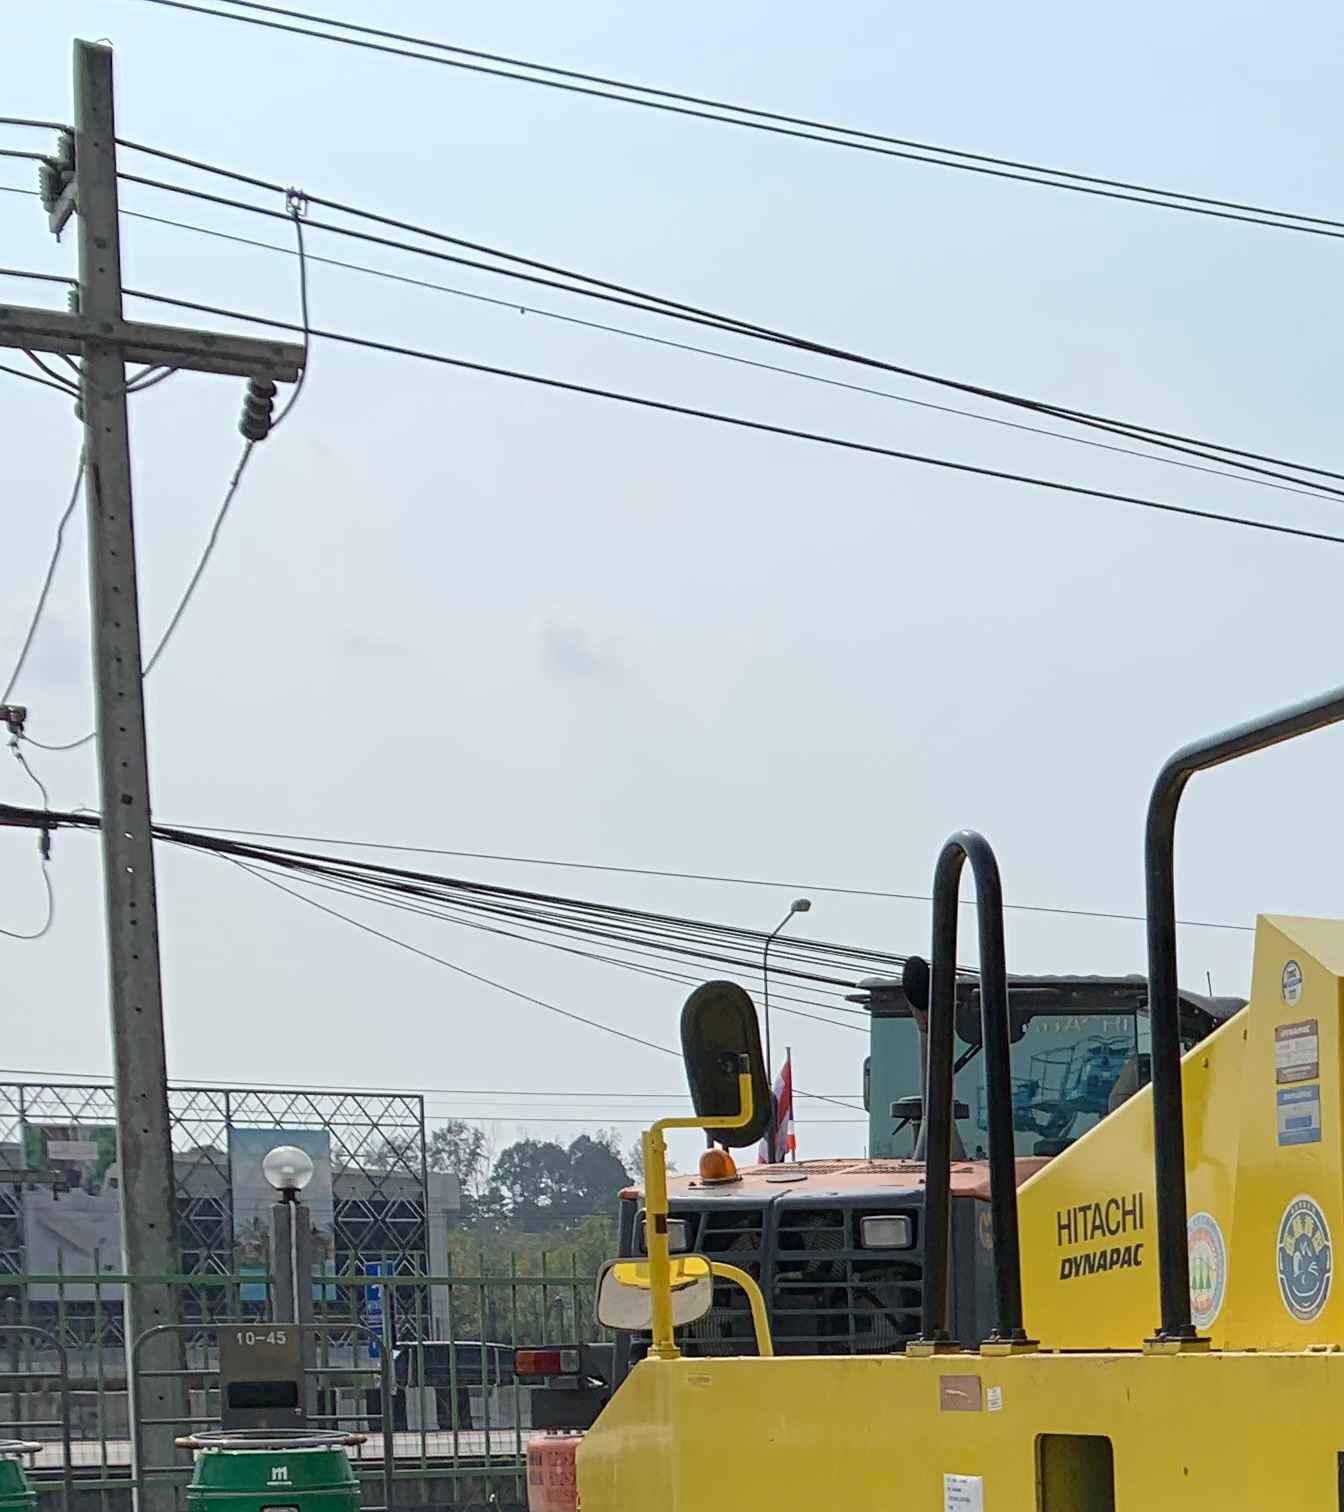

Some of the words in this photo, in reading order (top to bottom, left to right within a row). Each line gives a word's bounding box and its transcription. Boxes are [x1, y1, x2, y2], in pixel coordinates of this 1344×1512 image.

[1056, 1191, 1145, 1247] HITACHI
[1059, 1243, 1145, 1281] DYNAPAC
[236, 1330, 287, 1346] 10-45
